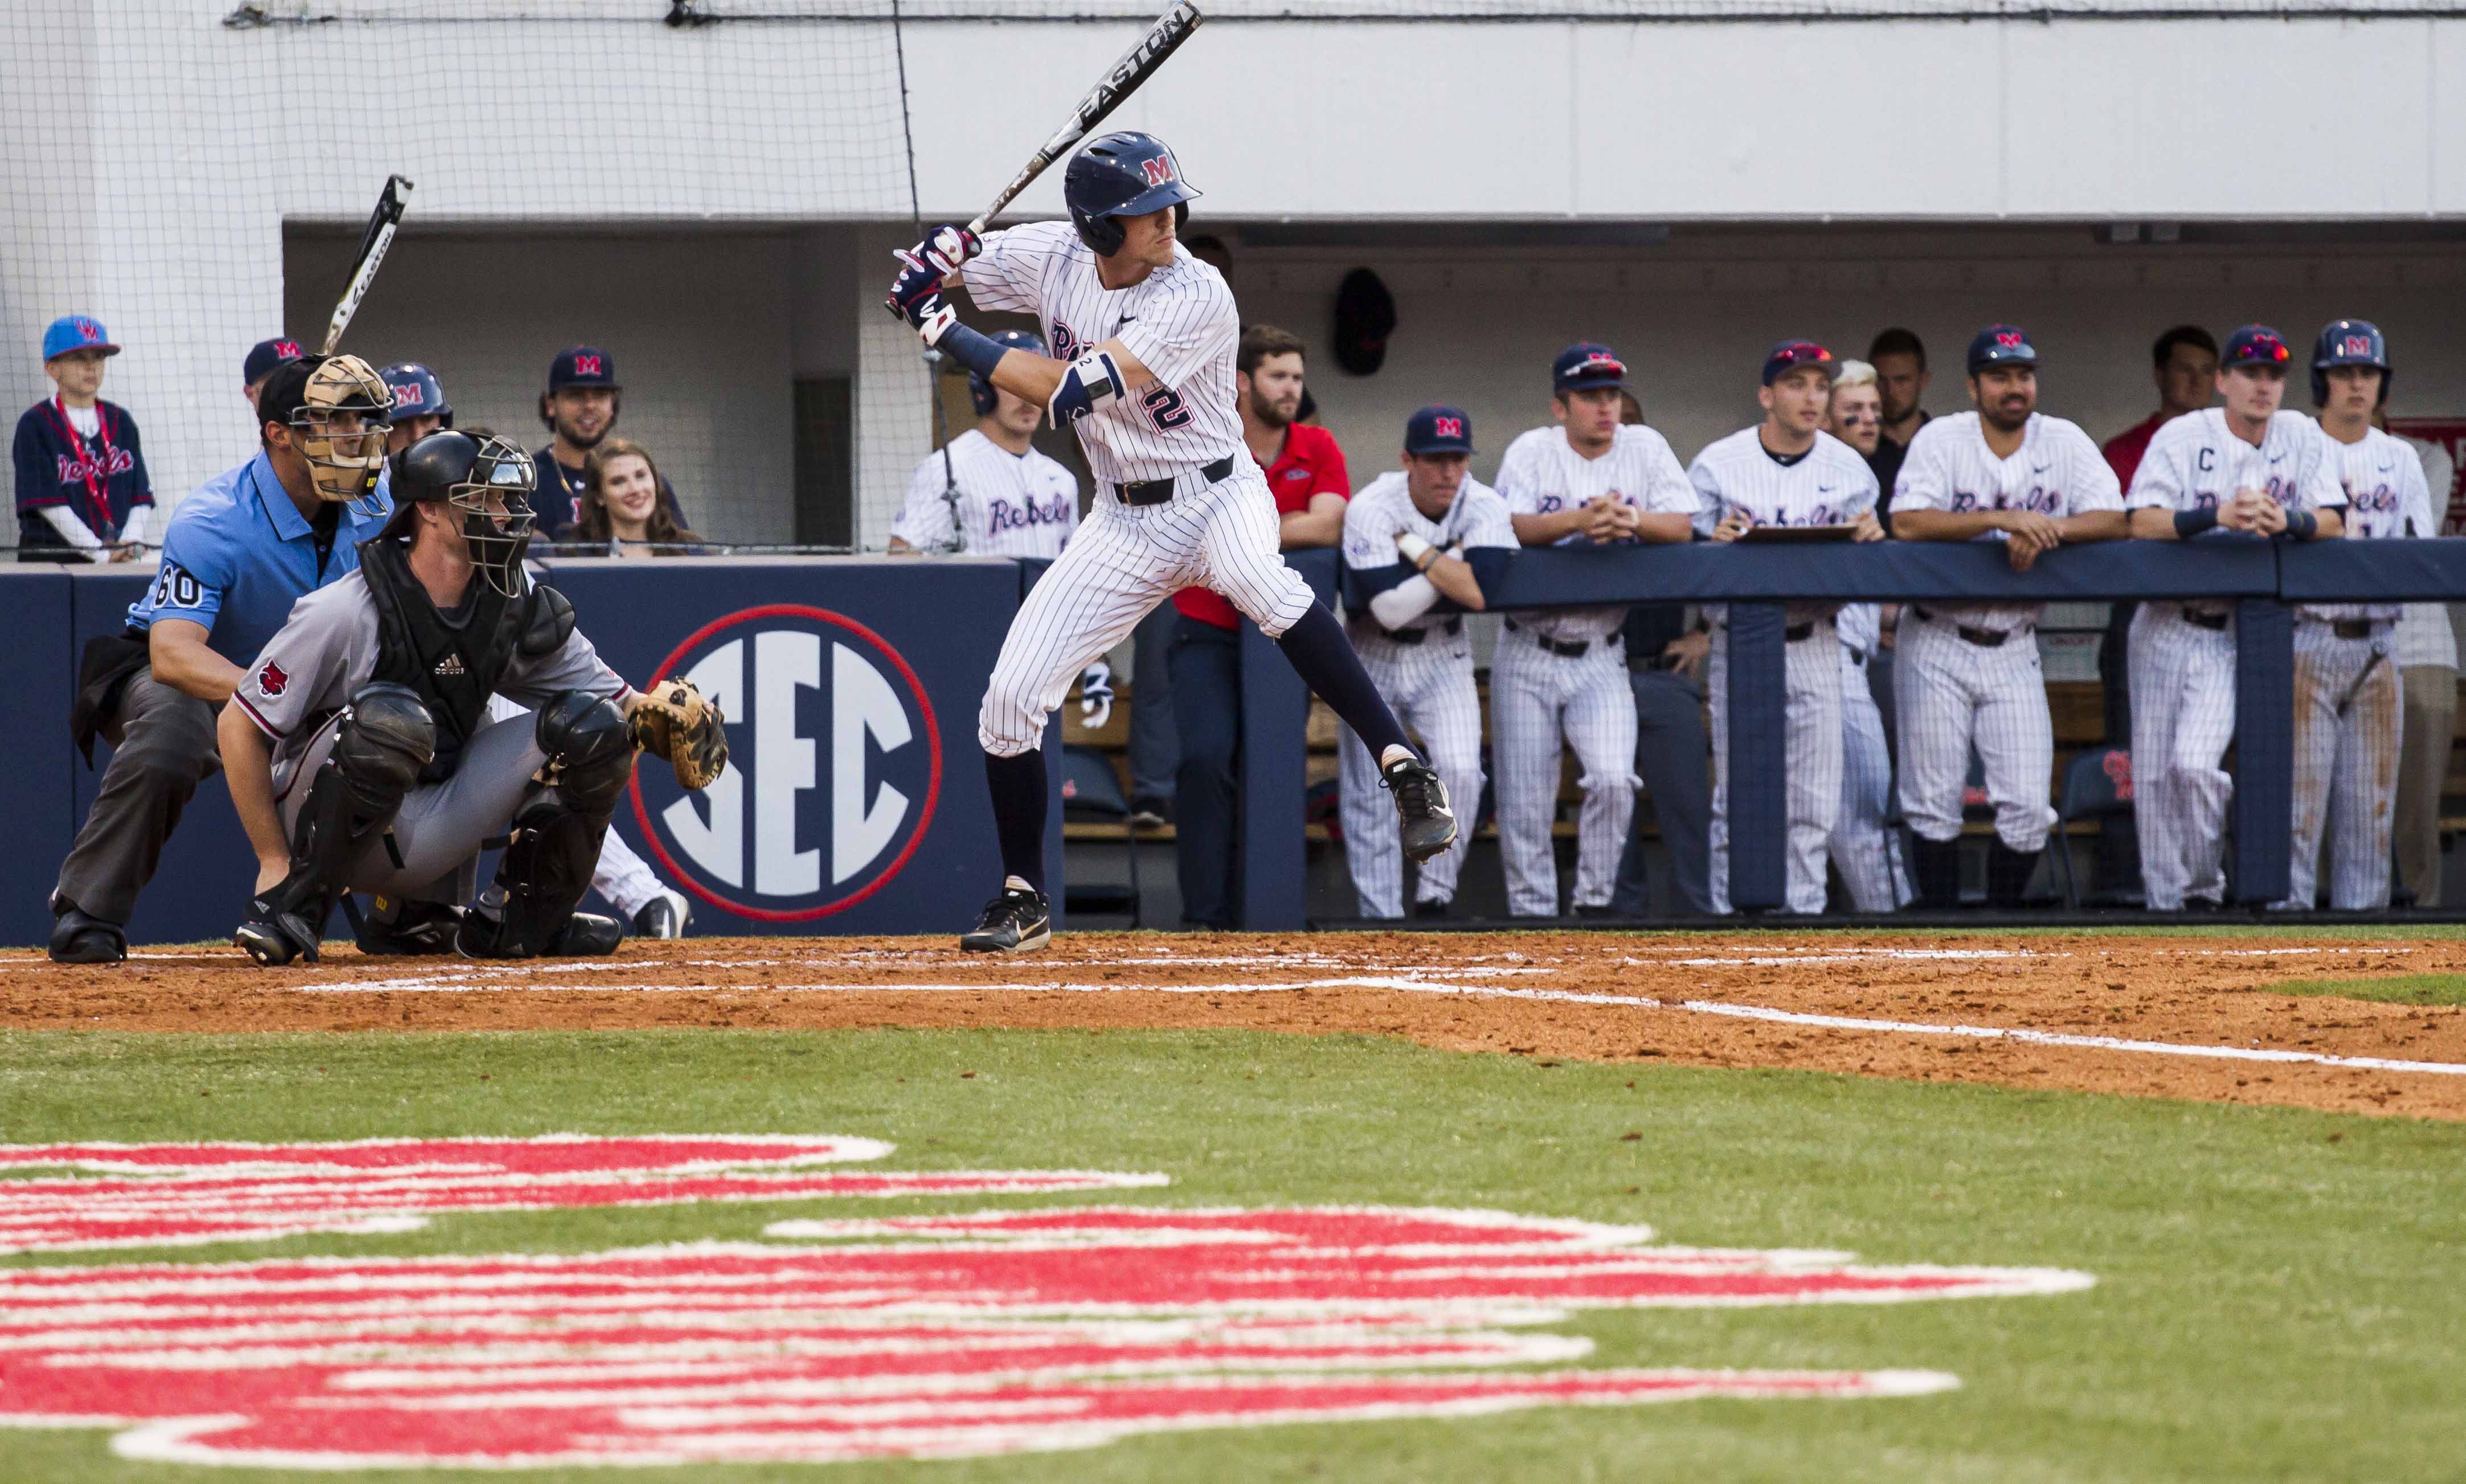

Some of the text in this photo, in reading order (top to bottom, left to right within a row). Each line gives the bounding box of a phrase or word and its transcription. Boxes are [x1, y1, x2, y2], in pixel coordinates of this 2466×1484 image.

[1077, 9, 1185, 125] EASTON
[1141, 154, 1176, 187] M
[361, 232, 392, 292] EASTON
[275, 342, 304, 359] M
[2345, 335, 2370, 356] M
[575, 355, 602, 375] M
[1078, 357, 1093, 367] 2
[395, 382, 424, 405] M
[1140, 385, 1195, 435] 2
[1436, 417, 1462, 438] M
[2199, 447, 2215, 472] C
[988, 492, 1070, 538] Rebels
[154, 564, 202, 609] 60
[662, 630, 913, 896] SEC
